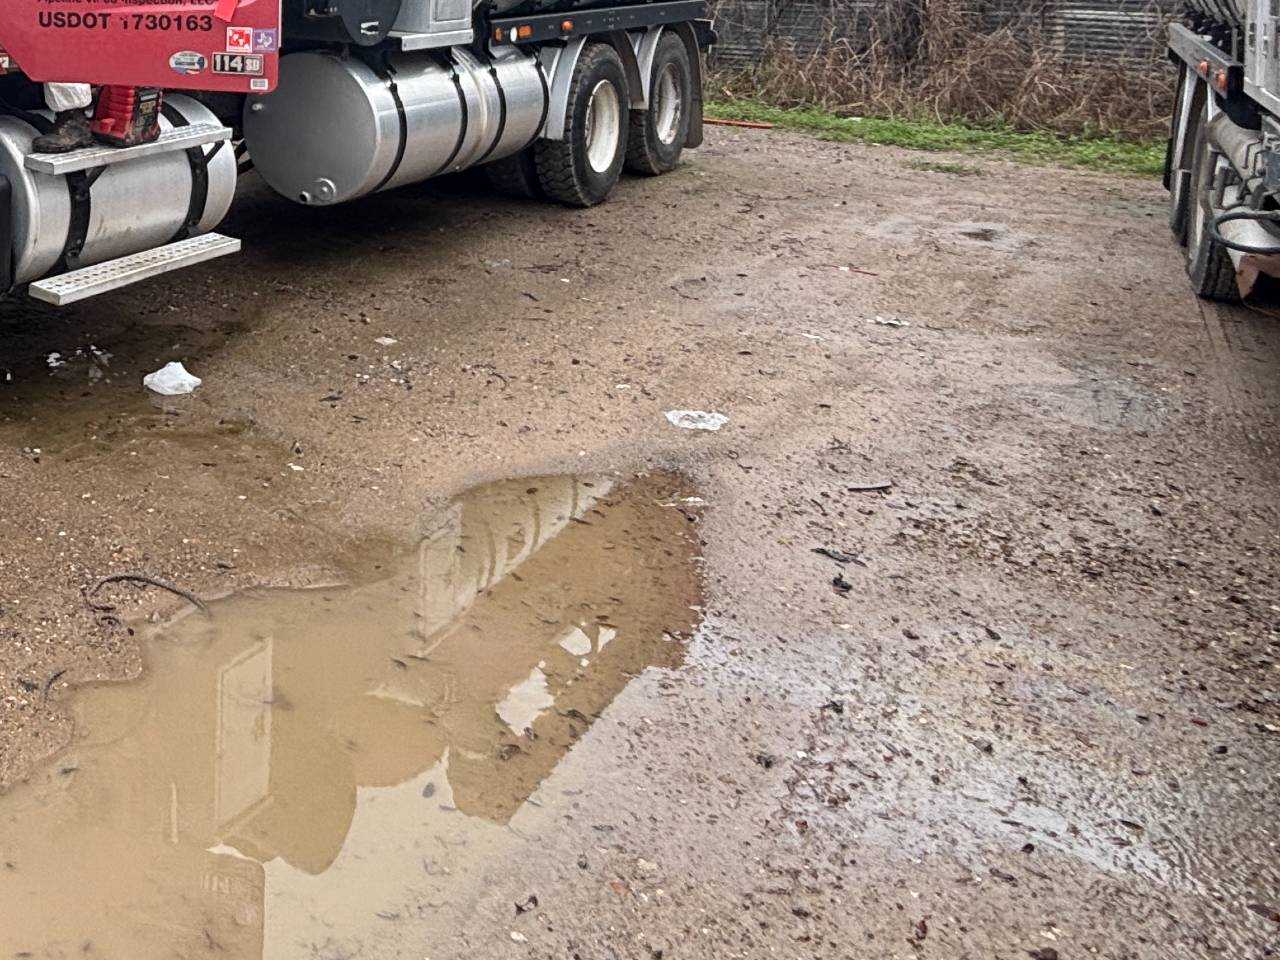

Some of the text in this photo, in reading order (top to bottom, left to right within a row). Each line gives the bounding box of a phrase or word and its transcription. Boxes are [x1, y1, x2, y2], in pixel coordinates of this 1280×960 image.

[38, 11, 213, 31] USDOT 1730163
[214, 54, 243, 72] 114
